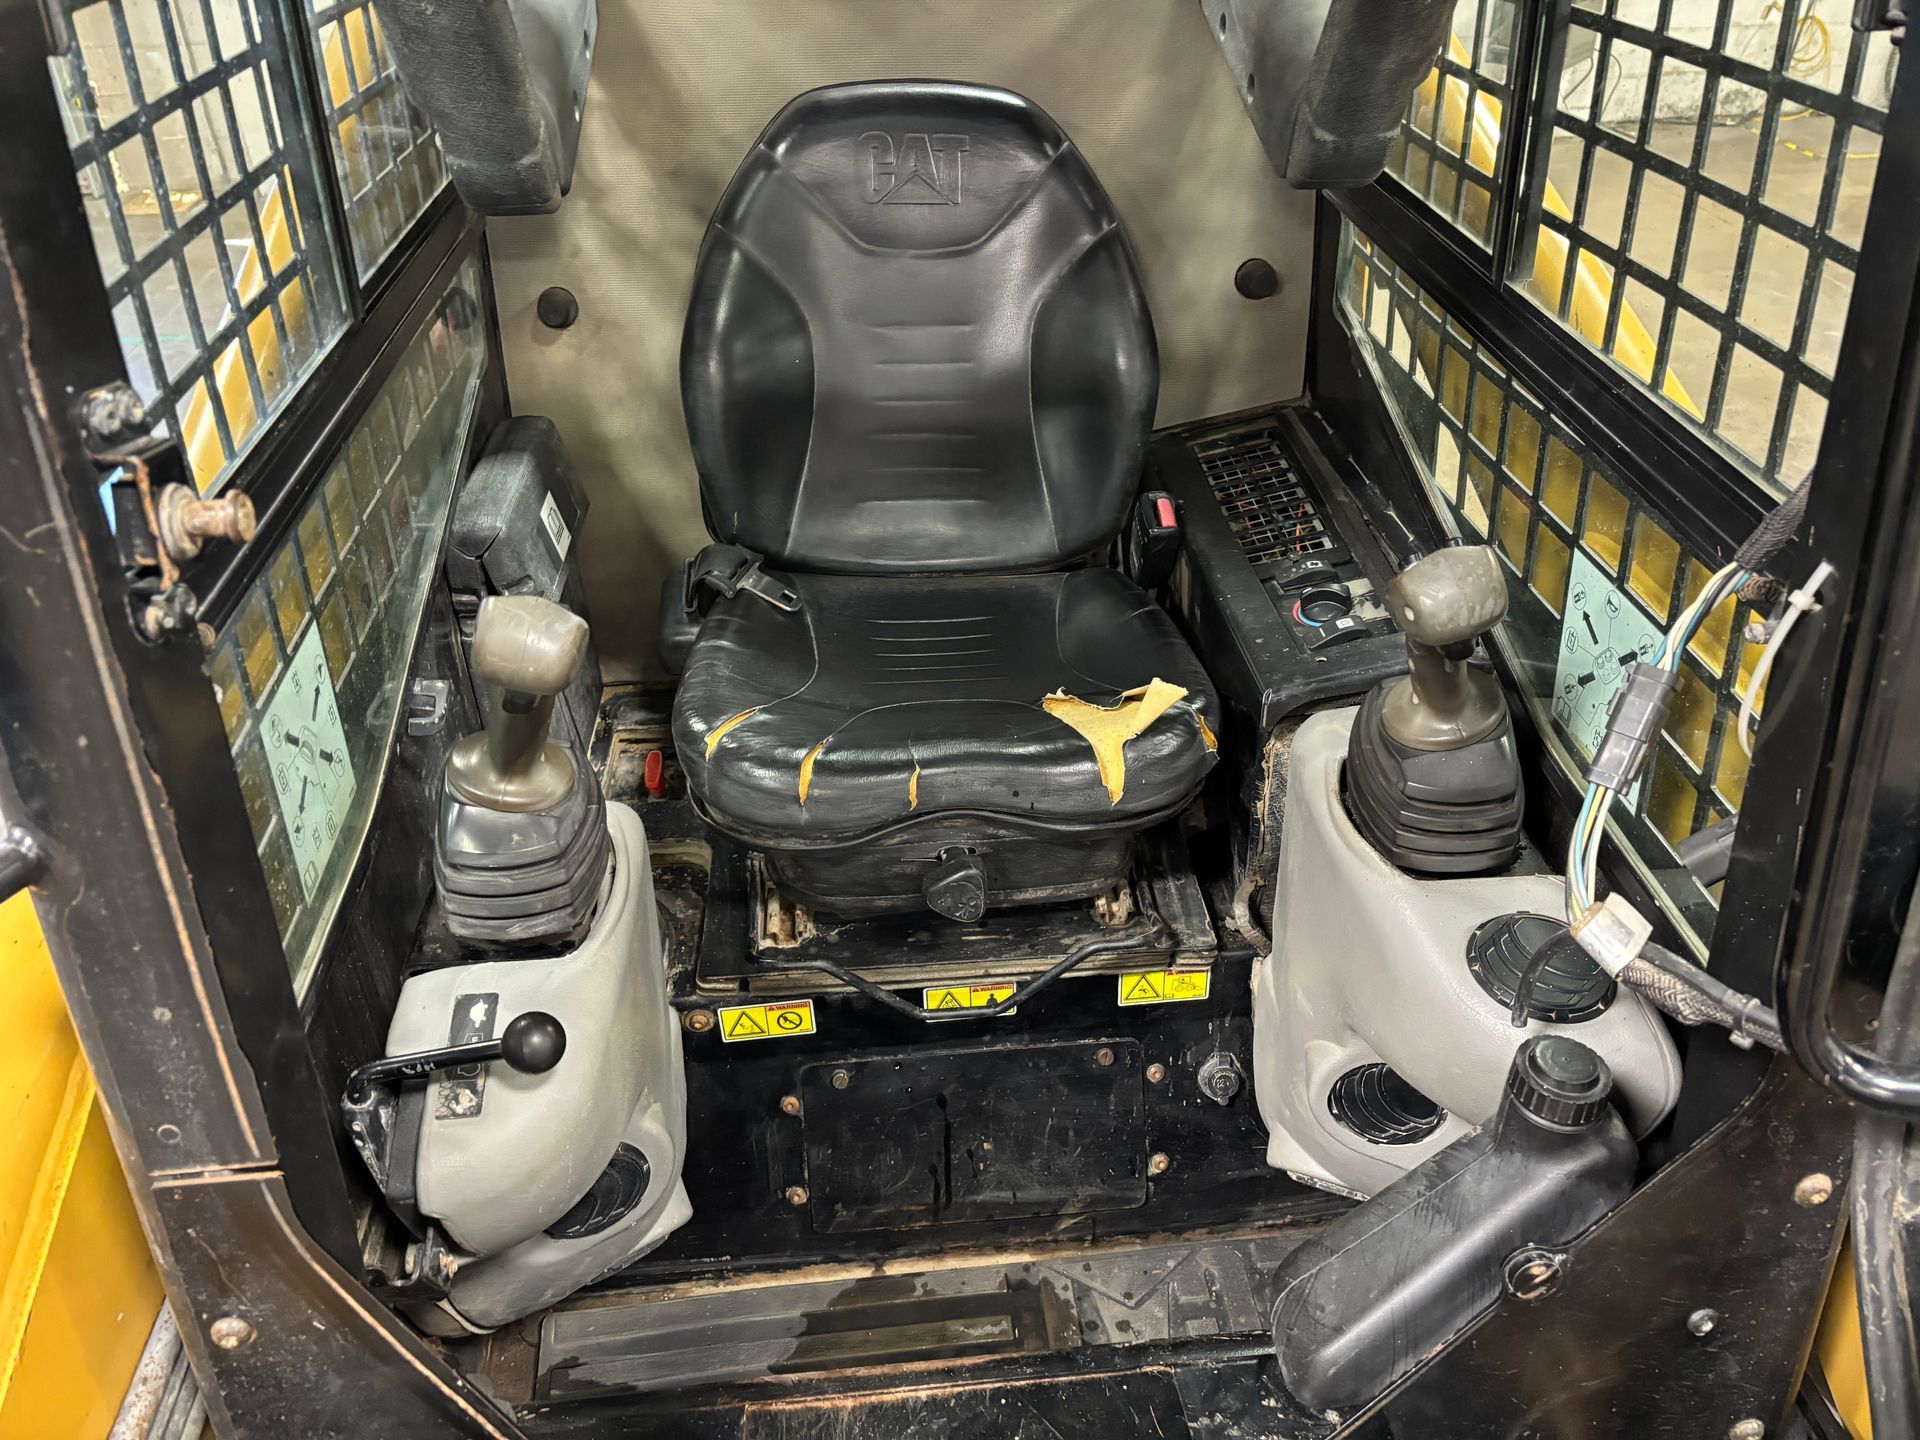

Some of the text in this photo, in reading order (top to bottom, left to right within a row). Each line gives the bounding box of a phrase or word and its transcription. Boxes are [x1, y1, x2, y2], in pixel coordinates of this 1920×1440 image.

[856, 131, 969, 205] CAT
[980, 984, 1012, 992] WARNING
[775, 1002, 808, 1011] WARNING
